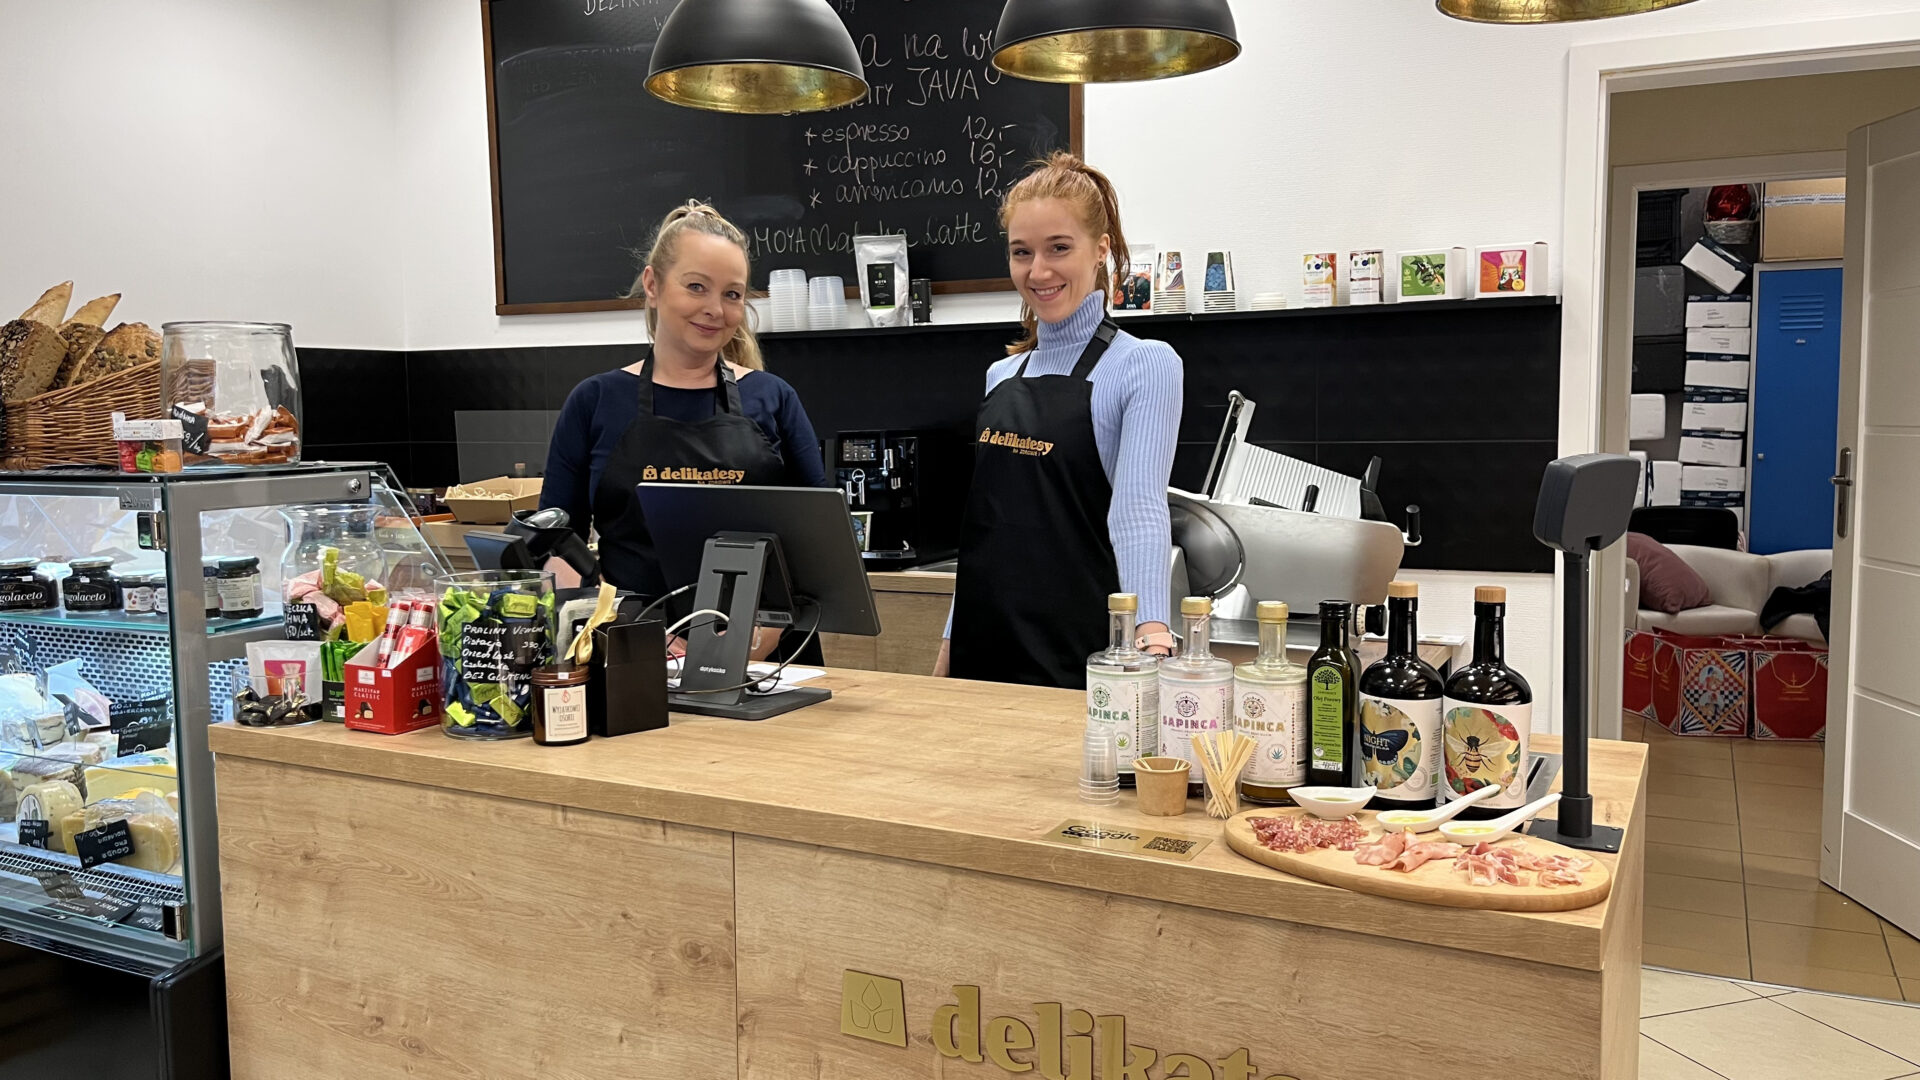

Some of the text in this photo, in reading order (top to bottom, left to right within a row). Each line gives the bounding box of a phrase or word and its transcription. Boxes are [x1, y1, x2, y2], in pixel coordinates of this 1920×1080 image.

[903, 33, 949, 60] na
[906, 67, 980, 106] JAVA
[821, 122, 910, 157] espresso
[827, 148, 947, 185] cappuccino
[835, 177, 964, 204] americano
[989, 430, 1054, 456] delikatesy
[660, 466, 745, 483] delikatesy
[462, 624, 508, 635] PRALINY
[463, 670, 485, 680] BEZ
[353, 691, 381, 701] CLASSIC
[1162, 714, 1219, 730] SAPINCA
[1363, 733, 1391, 748] NIGHT
[931, 983, 1301, 1080] delik
